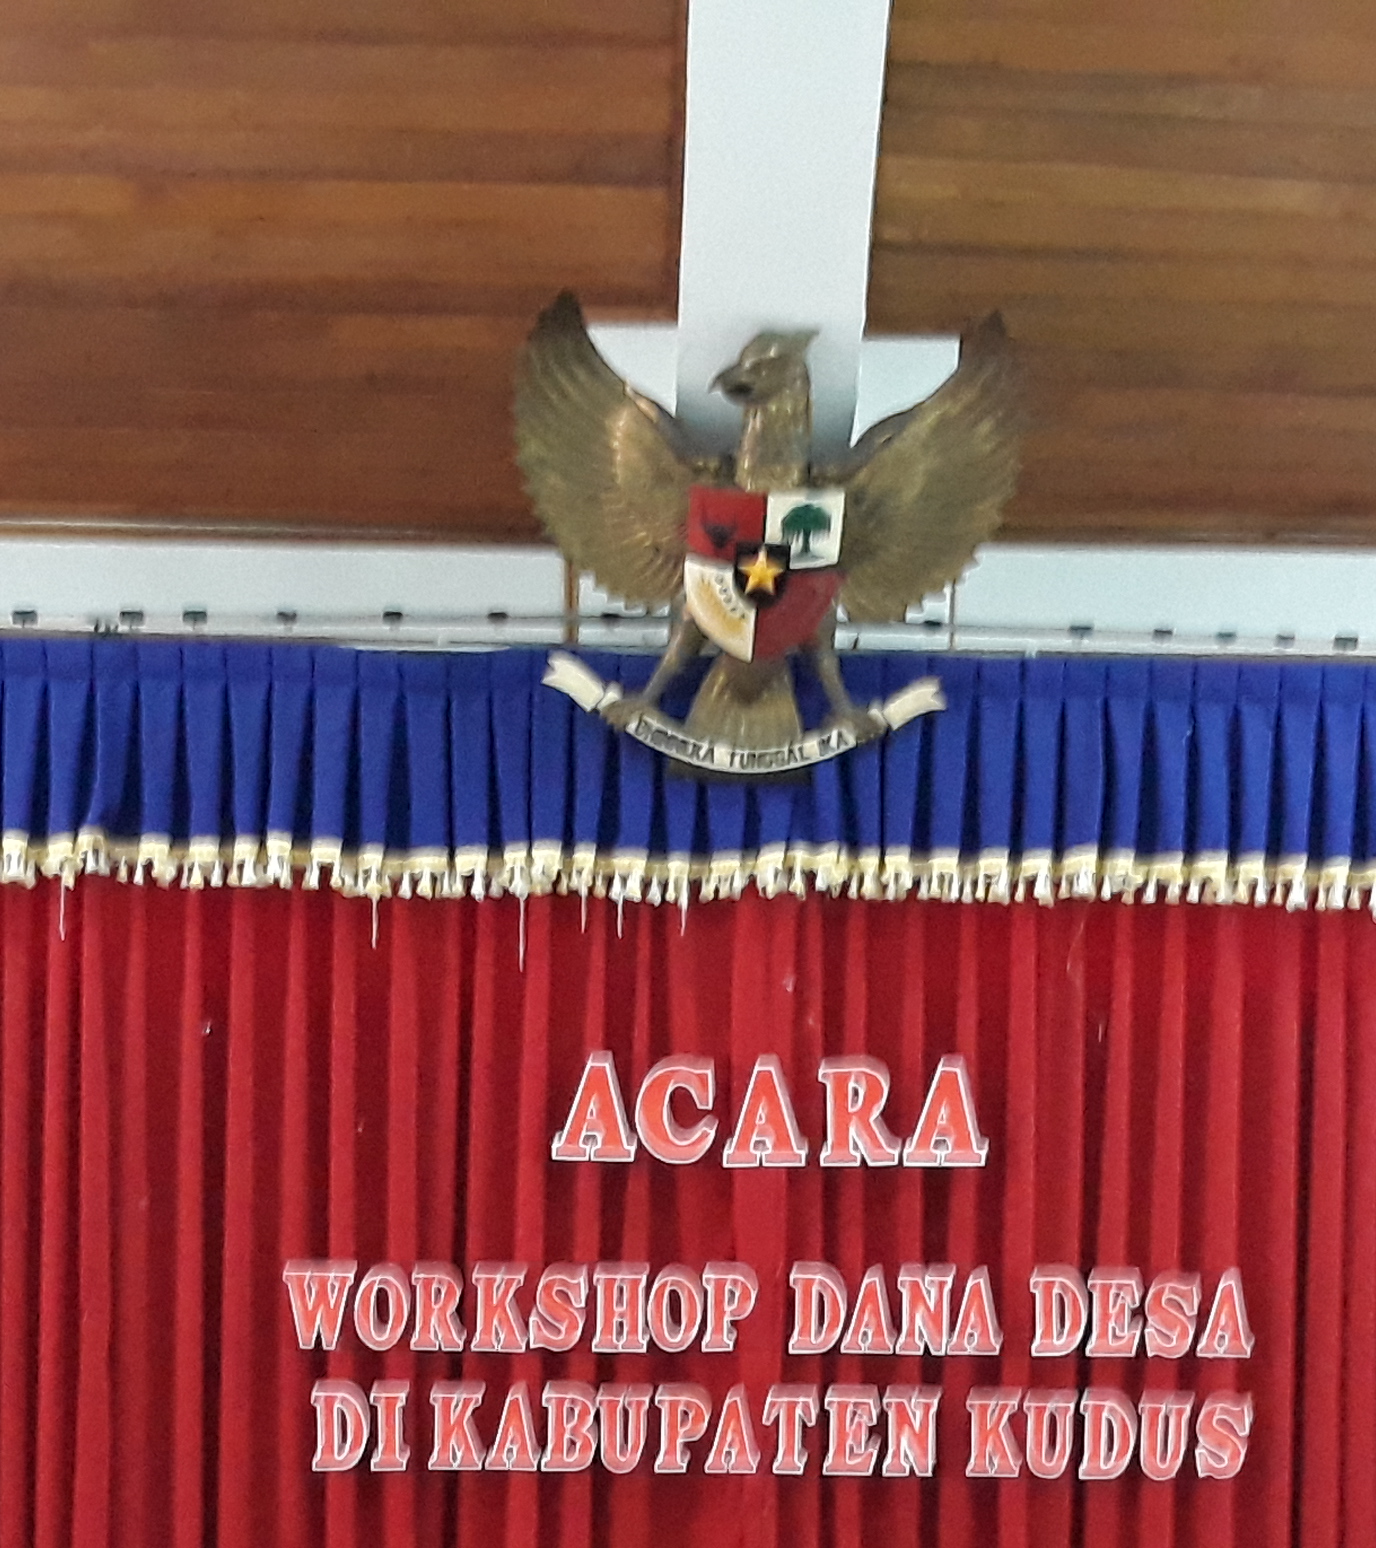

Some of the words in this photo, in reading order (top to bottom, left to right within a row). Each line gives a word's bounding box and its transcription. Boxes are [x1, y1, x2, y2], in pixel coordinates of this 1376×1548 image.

[550, 1051, 989, 1168] ACARA
[282, 1259, 758, 1354] WORKSHOP
[787, 1260, 1003, 1357] DANA
[1029, 1266, 1252, 1360] DESA
[312, 1381, 410, 1474] DI
[428, 1381, 941, 1478] KABUPATEN
[964, 1388, 1253, 1481] KUDUS
